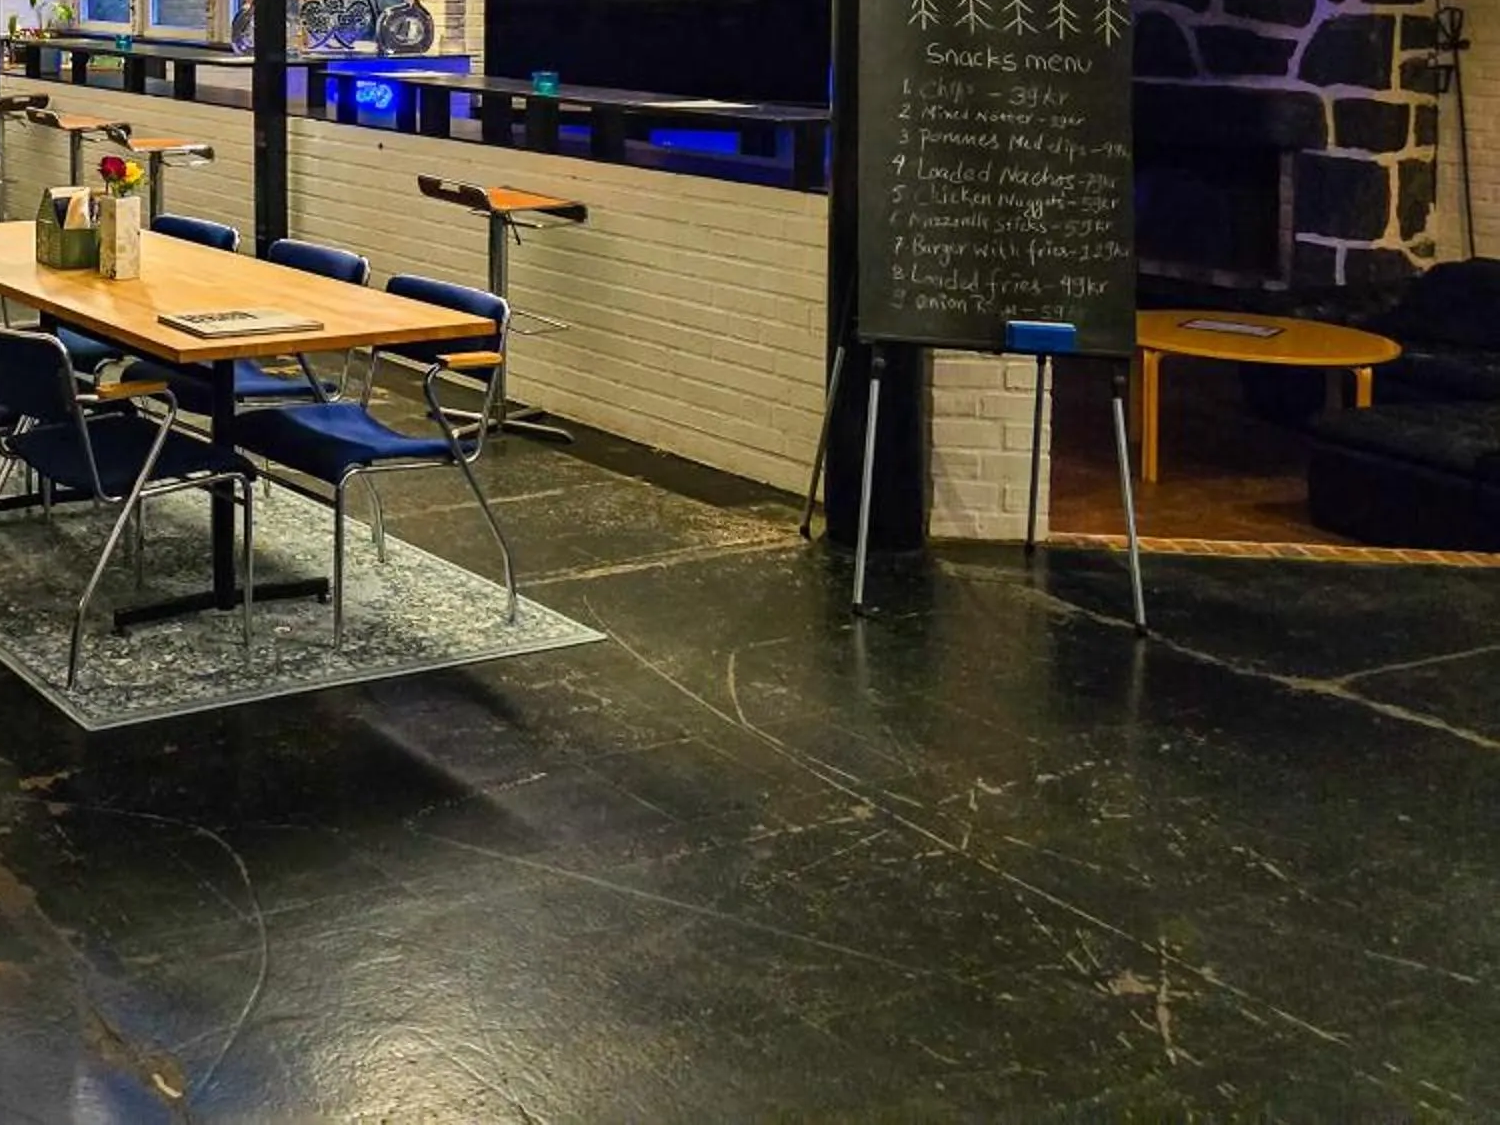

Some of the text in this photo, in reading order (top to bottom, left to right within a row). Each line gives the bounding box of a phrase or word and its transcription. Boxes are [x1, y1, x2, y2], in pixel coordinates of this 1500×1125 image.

[926, 42, 1093, 73] Snacks menu
[899, 128, 909, 144] 3
[892, 154, 906, 175] 4
[918, 157, 992, 184] Loaded
[999, 165, 1075, 190] Nachos
[892, 184, 906, 203] 5
[912, 233, 965, 268] Burger
[911, 263, 980, 291] Loaded
